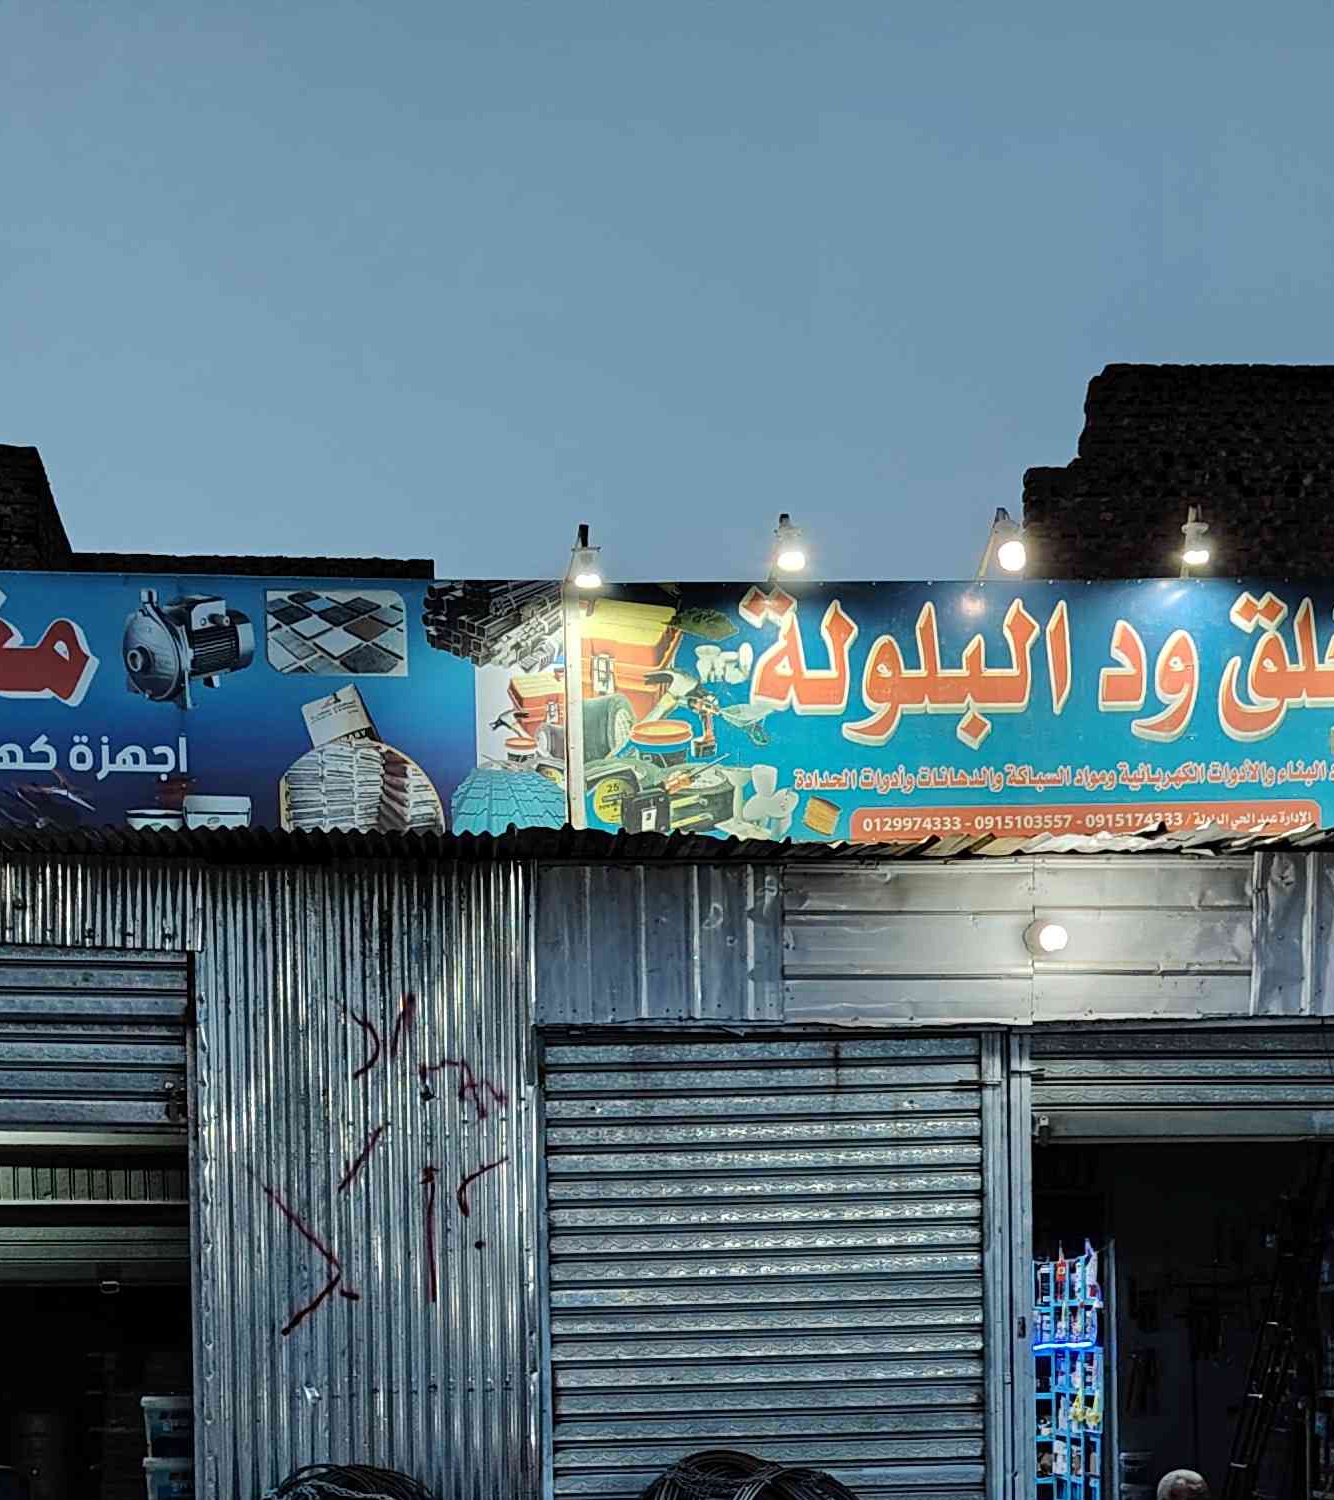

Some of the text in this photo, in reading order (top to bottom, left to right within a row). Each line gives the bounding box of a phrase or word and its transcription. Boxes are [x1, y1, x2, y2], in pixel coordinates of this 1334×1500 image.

[740, 586, 1071, 748] البلولة
[1098, 620, 1199, 742] ود
[69, 734, 189, 781] اجهزة
[793, 768, 857, 790] الحدادة
[917, 765, 1003, 792] والدهانات
[1003, 764, 1072, 792] السباكة
[1074, 765, 1116, 791] ومواد
[1117, 761, 1205, 791] الكهربائية
[1277, 759, 1326, 787] البناء
[862, 814, 962, 832] 0129974333
[974, 814, 1073, 831] 0915103557
[1085, 811, 1184, 829] 0915174333
